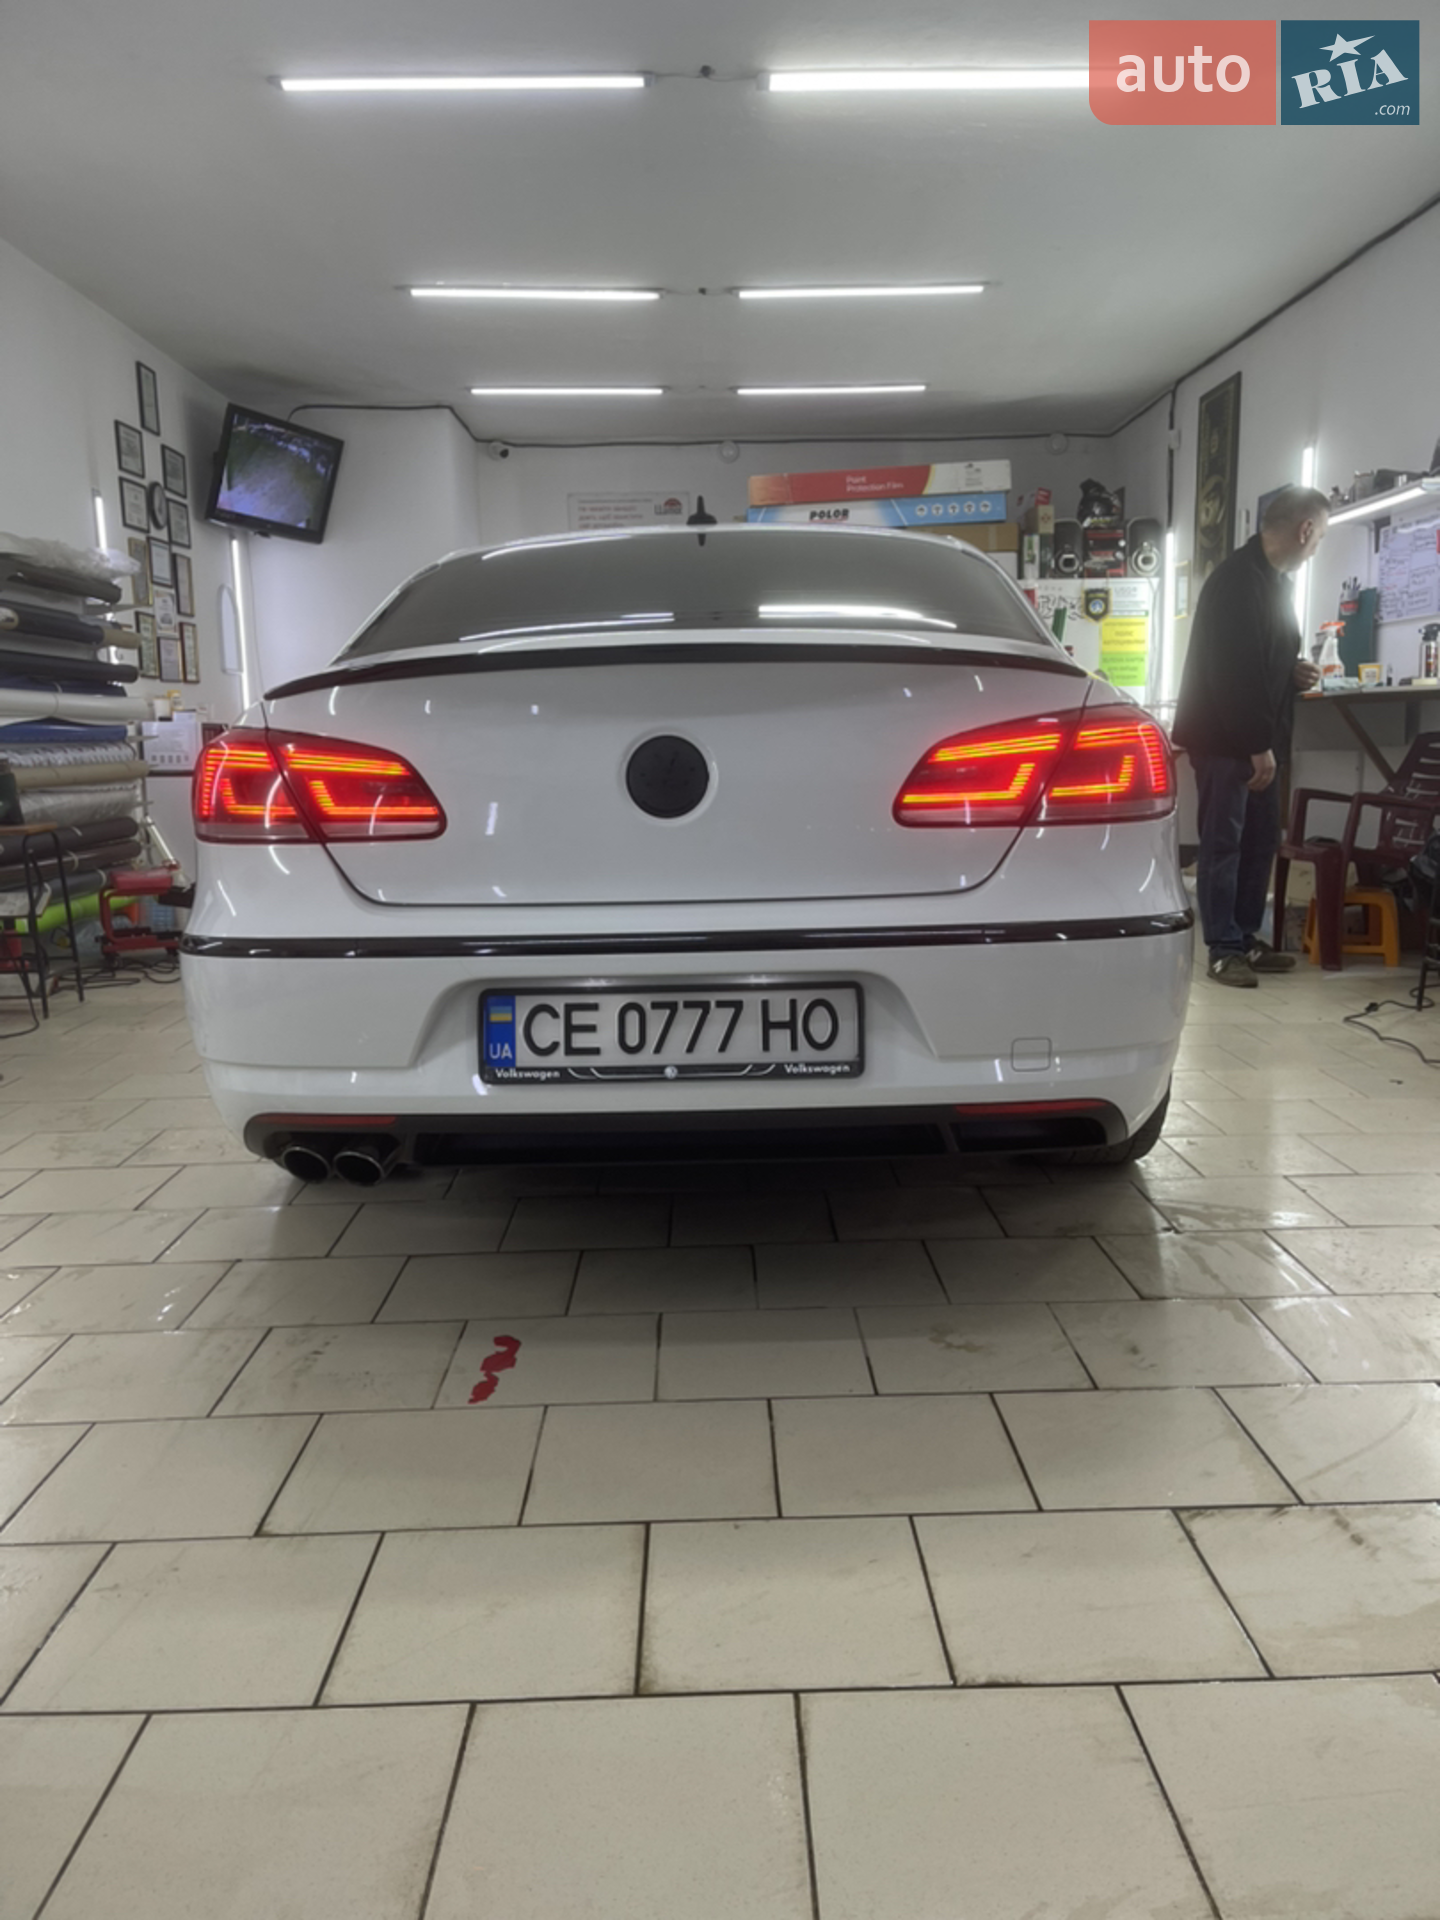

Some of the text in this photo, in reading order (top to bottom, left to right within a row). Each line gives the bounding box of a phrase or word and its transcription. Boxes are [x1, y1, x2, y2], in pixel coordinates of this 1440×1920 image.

[523, 997, 839, 1057] CE 0777 HO
[490, 1042, 513, 1059] UA
[495, 1068, 561, 1081] Volkswagen
[784, 1063, 851, 1076] Volkswagen
